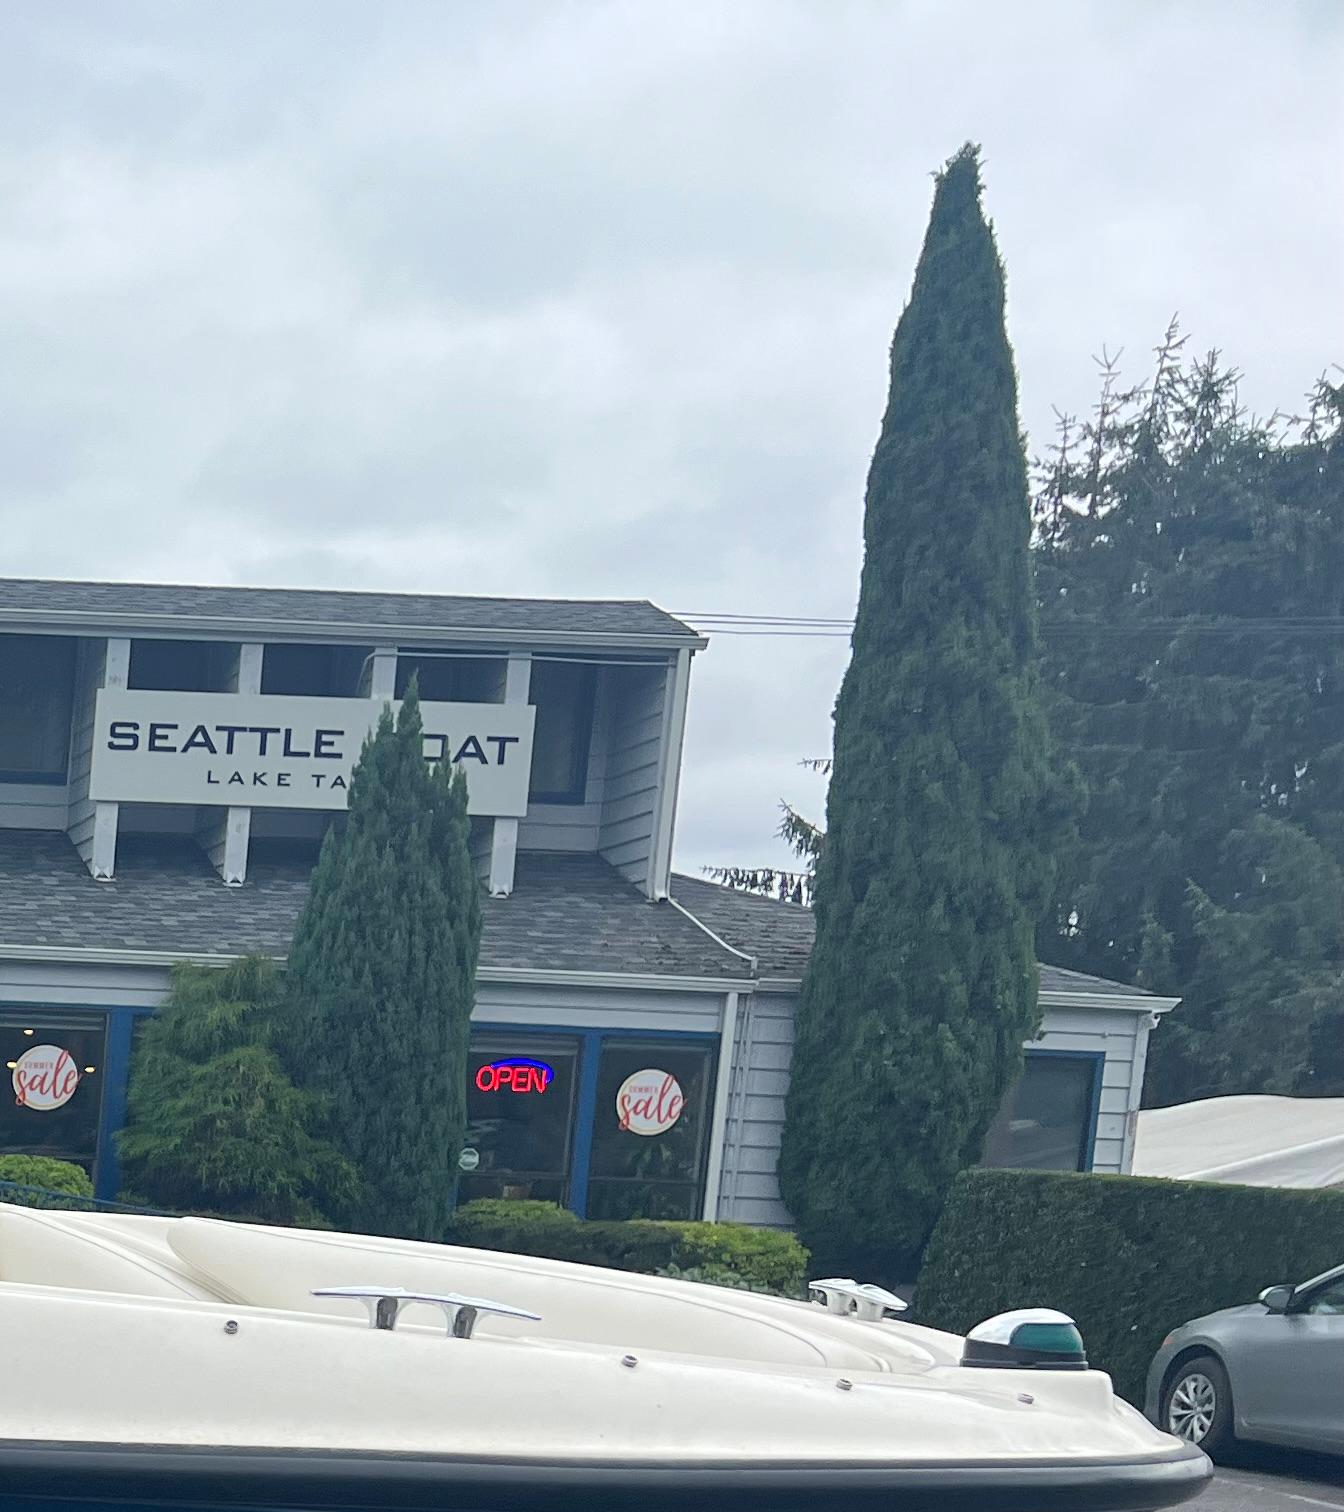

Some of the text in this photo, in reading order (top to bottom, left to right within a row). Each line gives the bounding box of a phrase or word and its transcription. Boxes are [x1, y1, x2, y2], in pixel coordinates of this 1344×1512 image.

[108, 721, 520, 766] SEATTLE OAT
[207, 769, 291, 788] LAKE
[475, 1064, 547, 1094] OPEN
